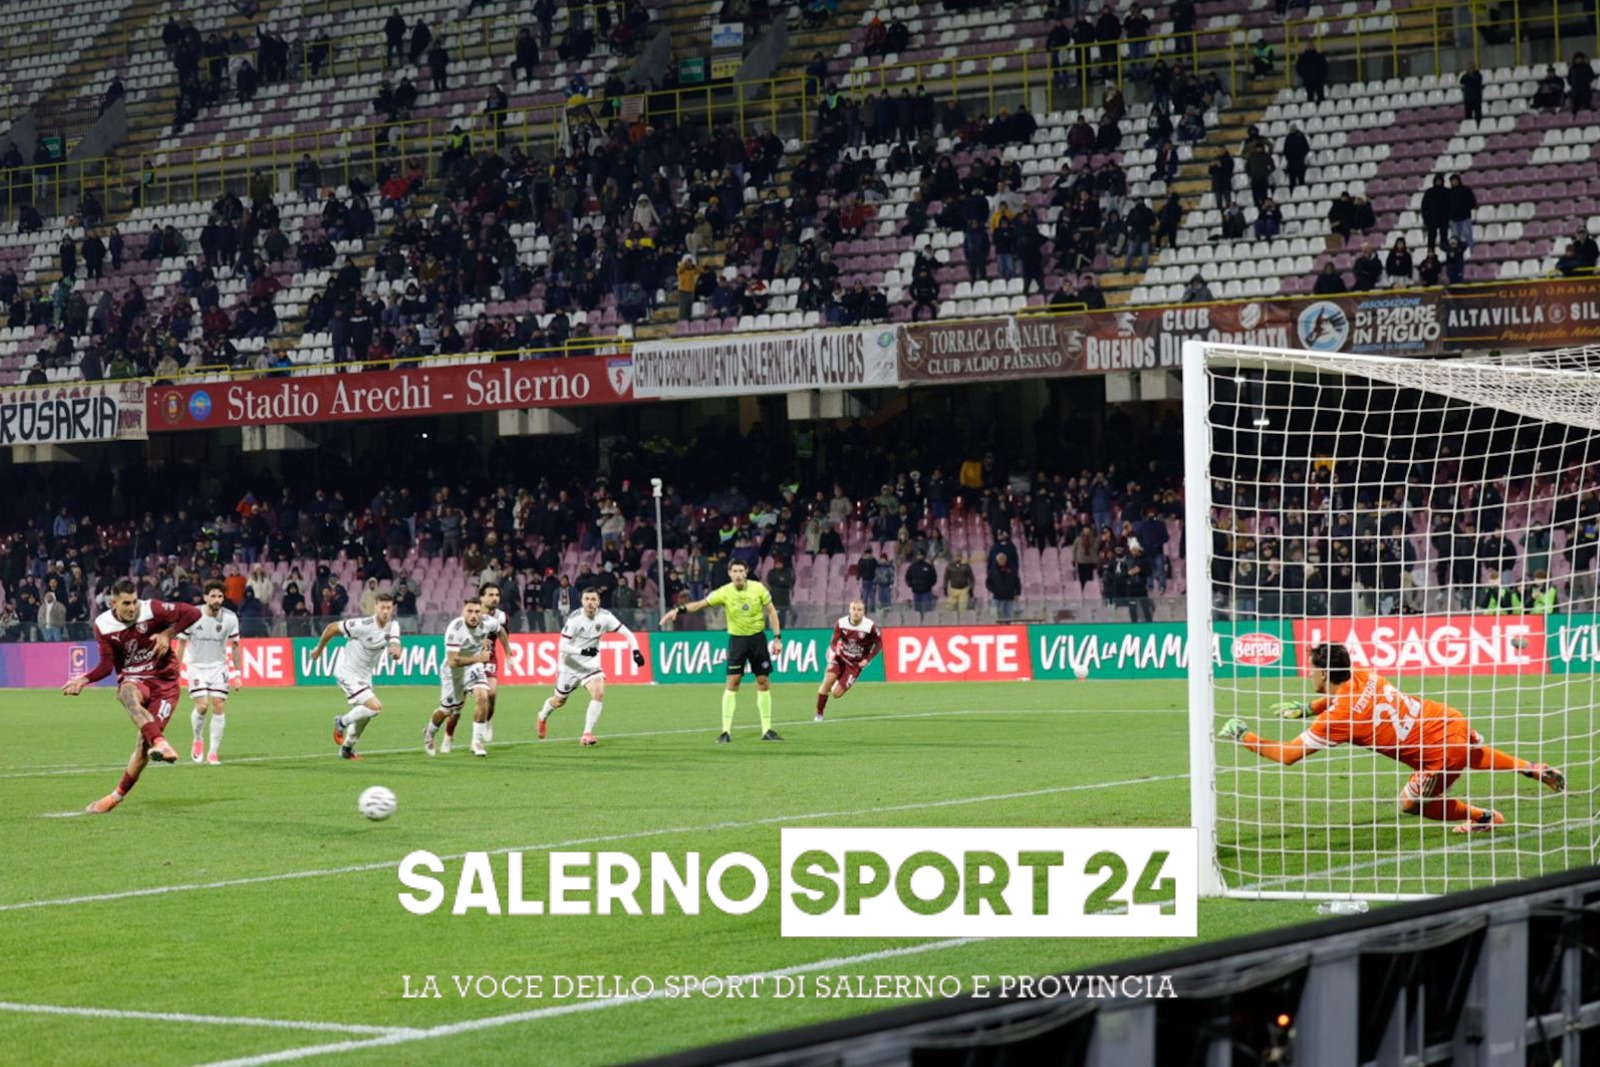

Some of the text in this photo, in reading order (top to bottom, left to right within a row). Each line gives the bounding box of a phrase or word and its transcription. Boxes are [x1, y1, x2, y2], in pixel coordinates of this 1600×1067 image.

[1162, 307, 1210, 331] CLUB
[1355, 304, 1436, 327] DI PADRE
[1448, 305, 1544, 327] ALTAVILLA
[930, 328, 991, 354] TORRACA
[1353, 322, 1441, 344] IN FIGLIO
[741, 333, 818, 386] SALERNITANA
[821, 331, 865, 384] CLUBS
[928, 352, 1062, 373] CLUB ALDO PAESANO
[1086, 336, 1155, 370] BUENOS
[228, 380, 319, 421] Stadio
[330, 375, 432, 415] Arechi
[466, 366, 590, 406] Salerno
[0, 396, 117, 444] ROSARIA
[899, 634, 1019, 674] PASTE
[1117, 633, 1223, 669] MAMA
[1234, 640, 1280, 658] Beretta
